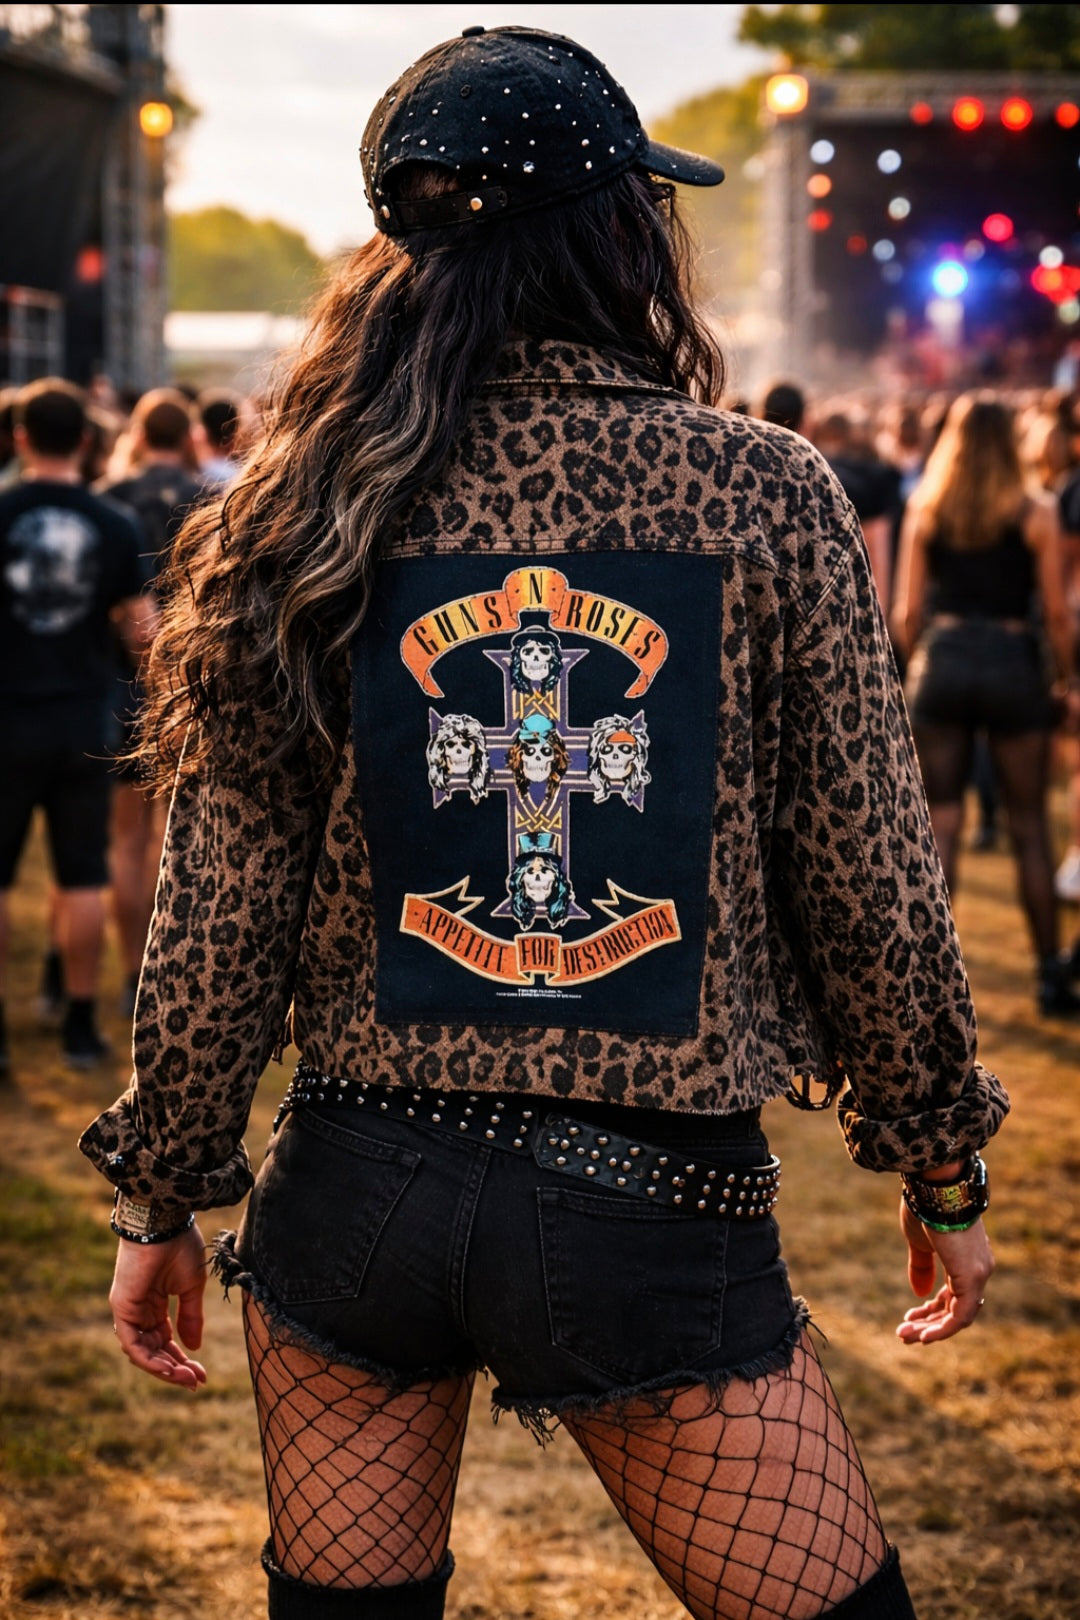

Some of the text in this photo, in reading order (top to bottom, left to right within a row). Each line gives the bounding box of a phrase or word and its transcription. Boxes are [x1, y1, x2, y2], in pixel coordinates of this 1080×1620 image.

[412, 596, 503, 656] GUNS
[565, 594, 661, 660] ROSES
[419, 908, 675, 976] APPETITE FOR DESTRUCTION
